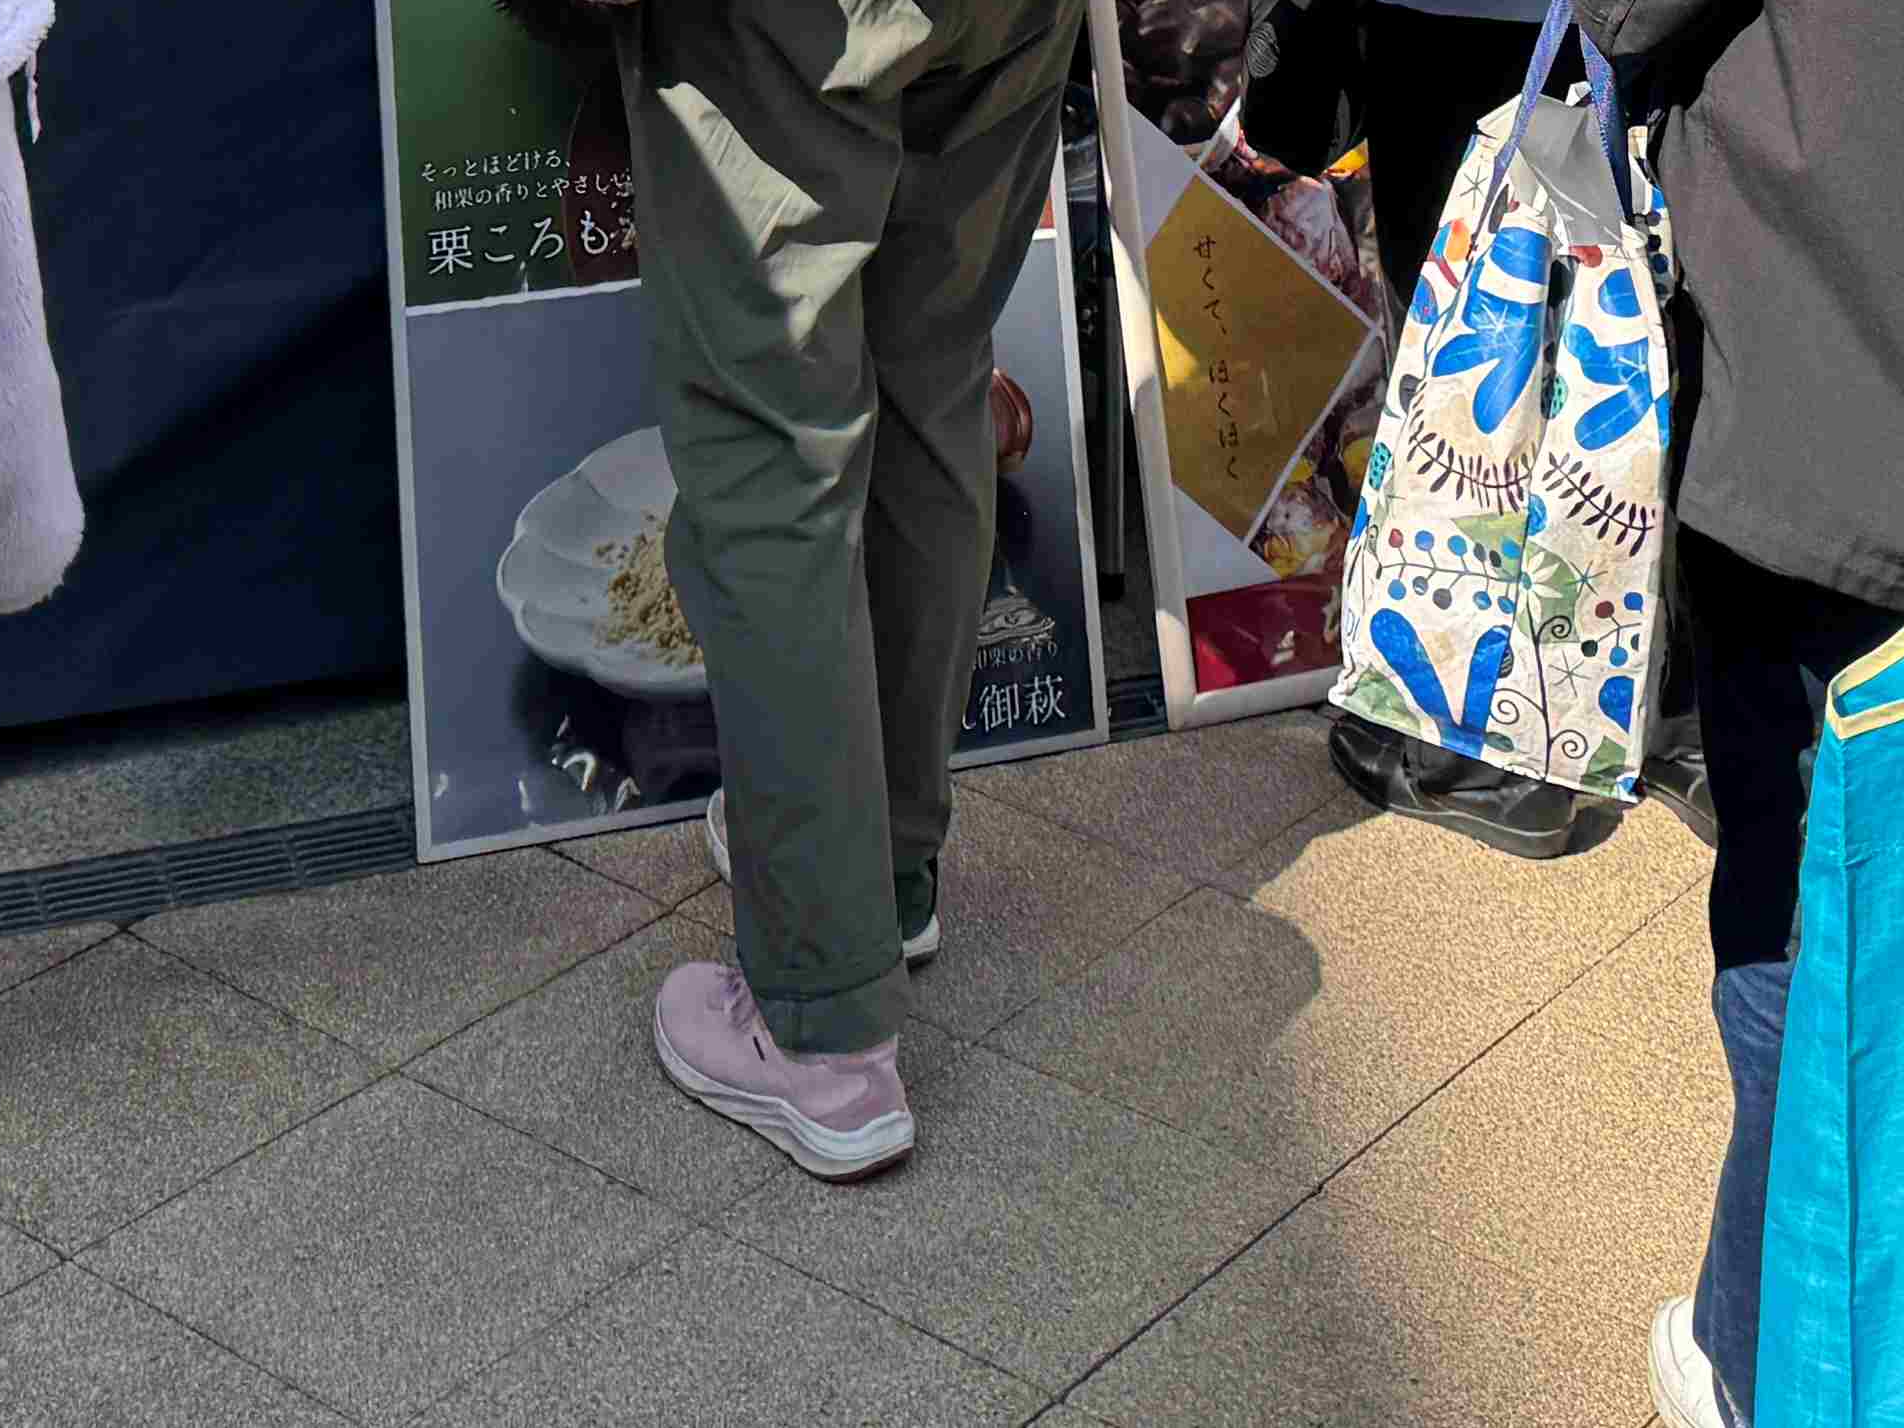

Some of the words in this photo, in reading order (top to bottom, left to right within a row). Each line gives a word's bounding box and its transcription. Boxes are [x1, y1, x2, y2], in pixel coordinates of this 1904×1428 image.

[420, 148, 572, 183] そっとほどける、
[1193, 235, 1228, 334] 甘くて、
[1208, 358, 1240, 481] ほくほく
